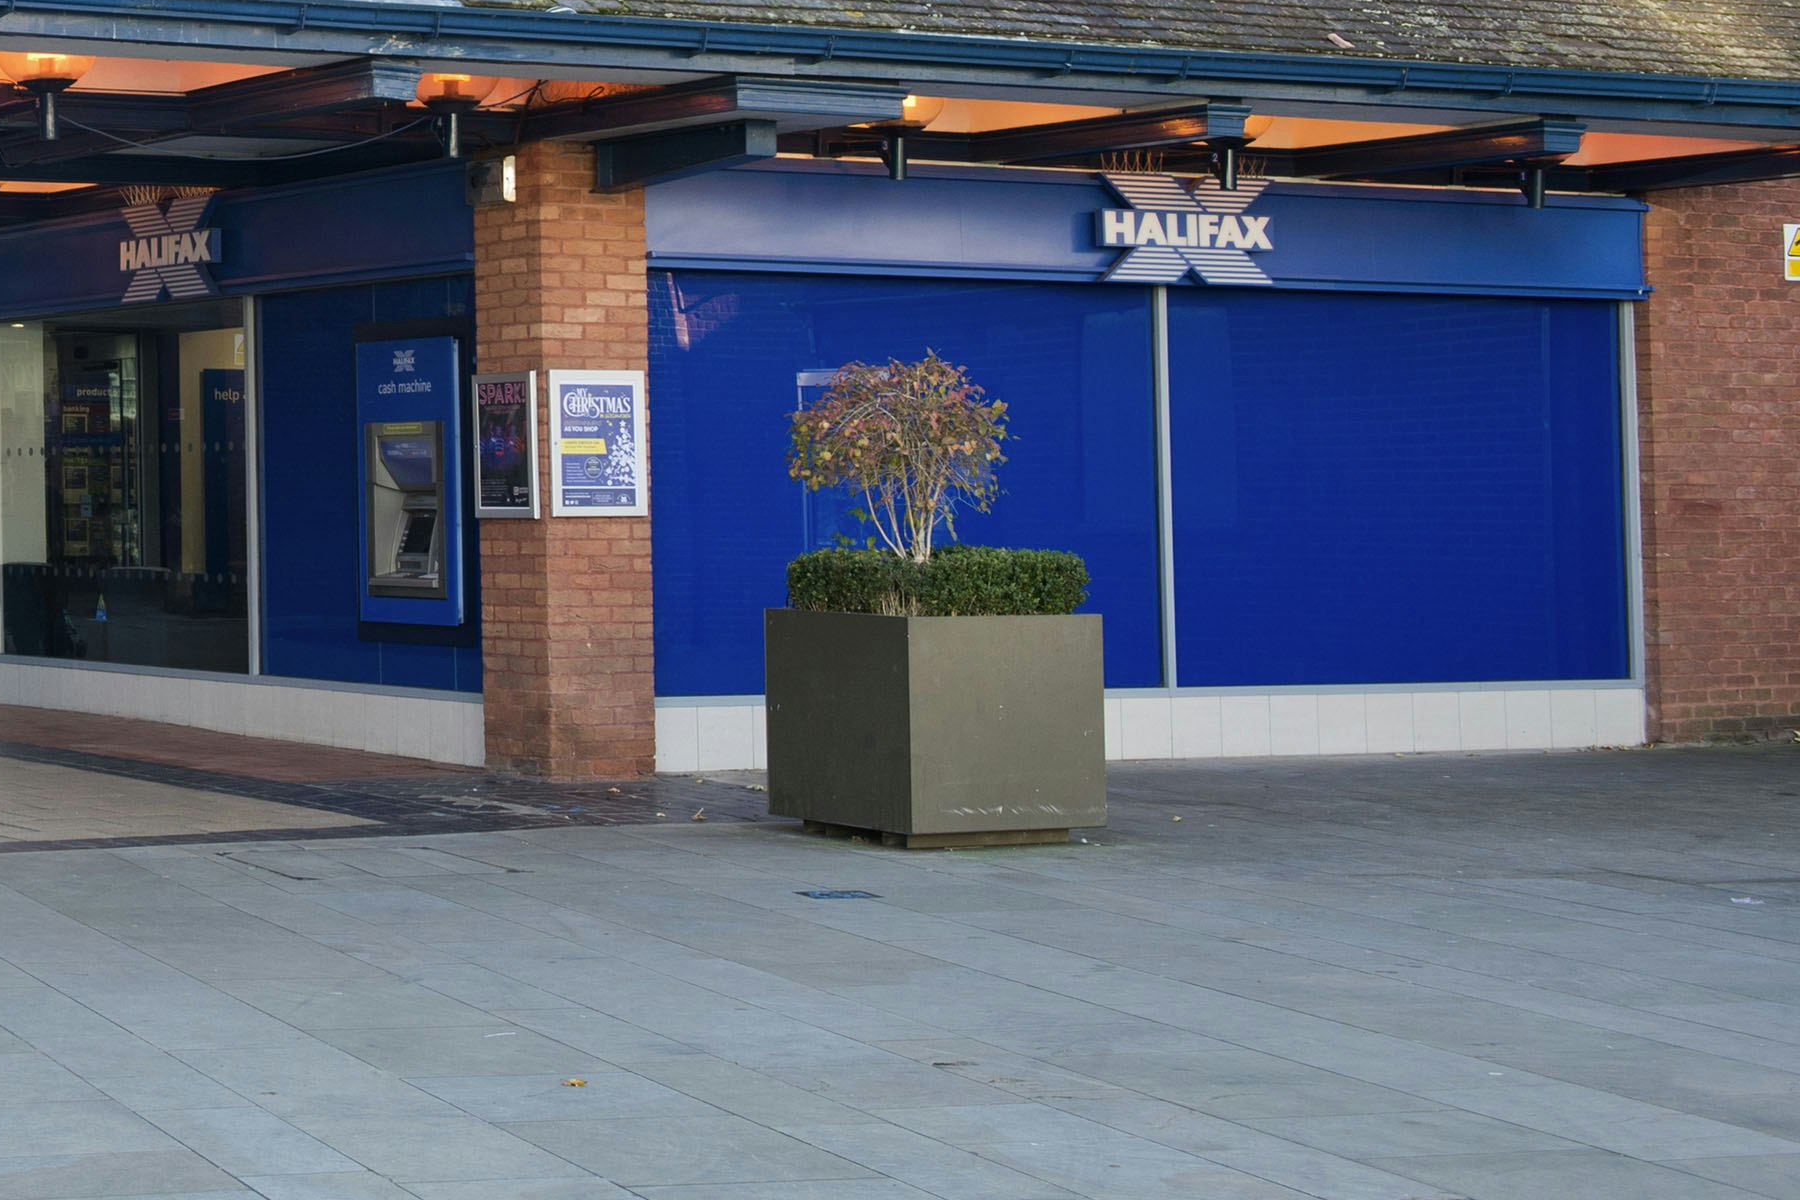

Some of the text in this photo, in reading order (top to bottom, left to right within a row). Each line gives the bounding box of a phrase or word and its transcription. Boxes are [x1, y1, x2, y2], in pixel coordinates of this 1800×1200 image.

[1212, 153, 1219, 163] 2
[1104, 210, 1274, 250] HALIFAX
[120, 229, 211, 272] HALIFAX
[214, 388, 240, 404] help
[378, 379, 432, 394] cash machine
[479, 383, 525, 405] SPARK!
[563, 391, 632, 419] CHRISTMAS
